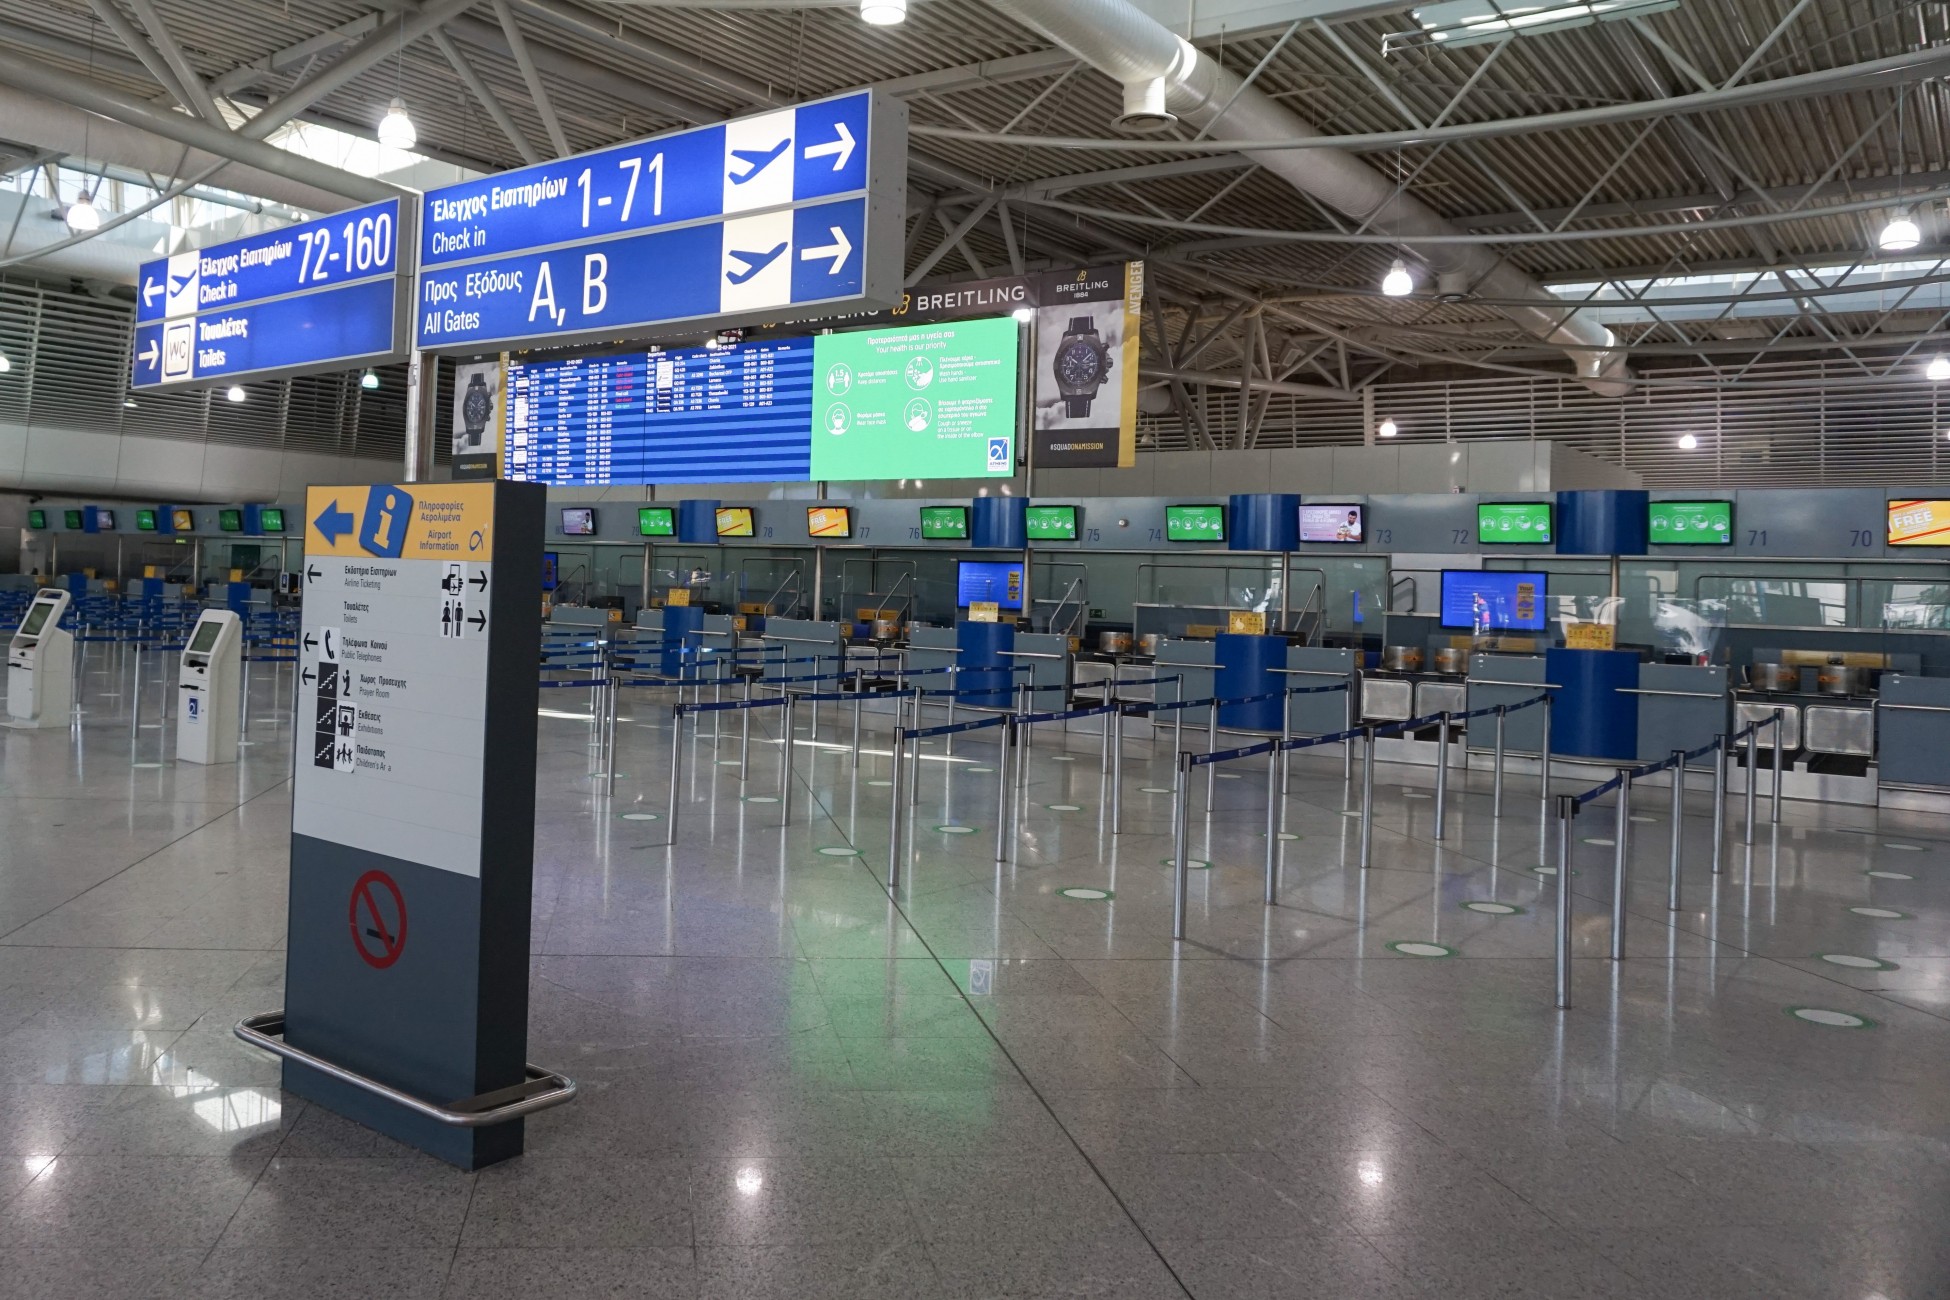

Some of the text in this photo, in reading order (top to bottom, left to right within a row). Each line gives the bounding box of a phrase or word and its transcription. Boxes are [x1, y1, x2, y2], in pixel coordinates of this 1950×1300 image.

[578, 152, 664, 228] 1-71
[430, 175, 568, 226] Έλεγχος Εισιτηρίων
[431, 224, 486, 255] Check in
[298, 212, 392, 284] 72-160
[200, 240, 293, 278] Έλεγχος Εισιτηρίων
[425, 268, 523, 304] Προς Εξόδους
[528, 252, 609, 326] A, B
[1056, 280, 1109, 293] BREITLING
[1129, 260, 1144, 315] AVENGER
[200, 283, 237, 304] Check in
[917, 286, 1025, 310] BREITLING
[424, 307, 480, 335] All Gates
[200, 317, 248, 342] Τουαλέτες
[169, 339, 187, 361] WC
[890, 344, 907, 352] health
[926, 341, 947, 351] priority
[199, 348, 226, 368] Toilets
[835, 369, 844, 377] 1.5
[419, 501, 464, 515] Πληροφορίες
[420, 512, 461, 523] Αερολιμένα
[1893, 511, 1933, 528] FREE
[428, 530, 452, 541] Airport
[764, 526, 773, 538] 78
[860, 528, 870, 539] 77
[909, 527, 920, 539] 76
[1087, 529, 1100, 542] 75
[1148, 528, 1161, 541] 74
[1376, 529, 1392, 544] 73
[1452, 530, 1468, 544] 72
[1747, 530, 1768, 546] 71
[1850, 530, 1872, 547] 70
[419, 541, 459, 551] Information
[344, 578, 381, 591] Airline Ticketing
[344, 600, 369, 613] Τουαλέτες
[343, 613, 358, 624] Toilets
[342, 636, 388, 650] Τηλέφωνα Κοινού
[341, 649, 382, 663] Public Telephones
[359, 686, 390, 699] Prayer Room
[358, 709, 381, 723] Εκθέσεις
[357, 723, 384, 735] Exhibitions
[355, 757, 379, 770] Children's
